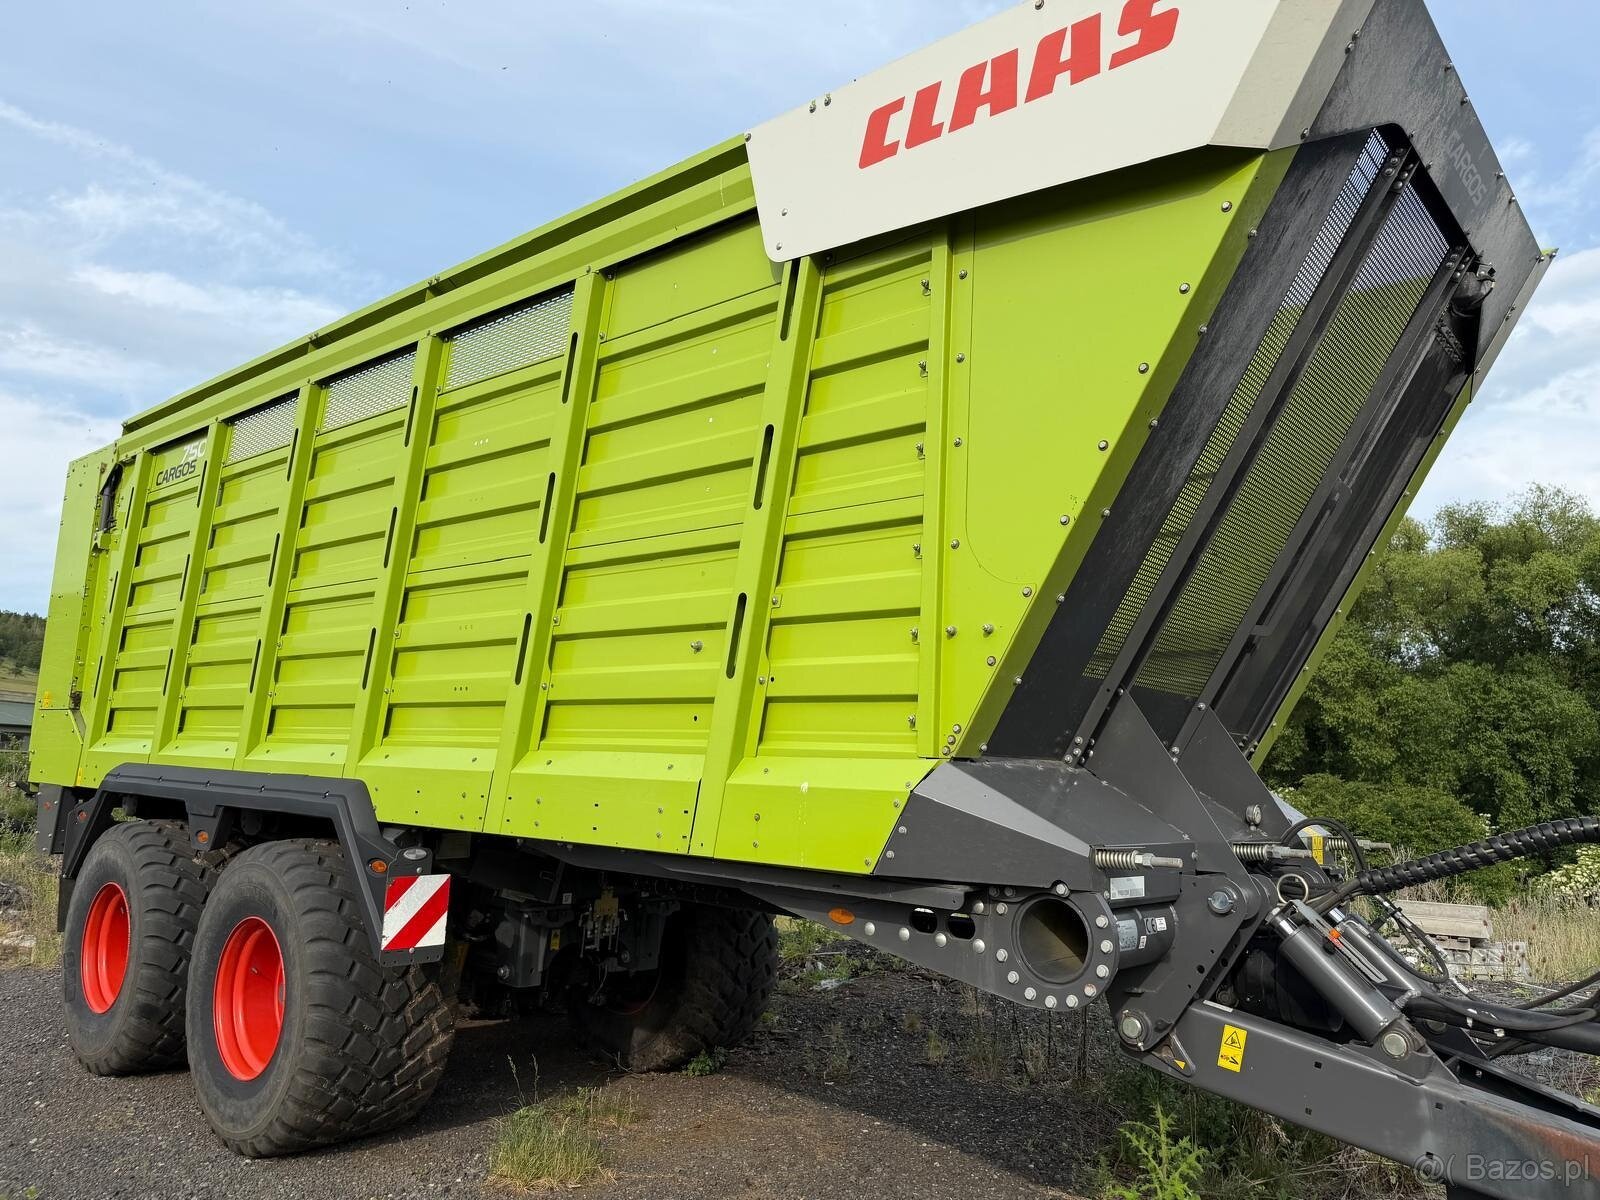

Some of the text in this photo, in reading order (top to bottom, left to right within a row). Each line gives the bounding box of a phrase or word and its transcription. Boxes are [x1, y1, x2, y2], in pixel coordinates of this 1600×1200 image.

[859, 0, 1179, 169] CLAAS
[1446, 130, 1487, 206] CARGOS
[156, 459, 198, 486] CARGOS
